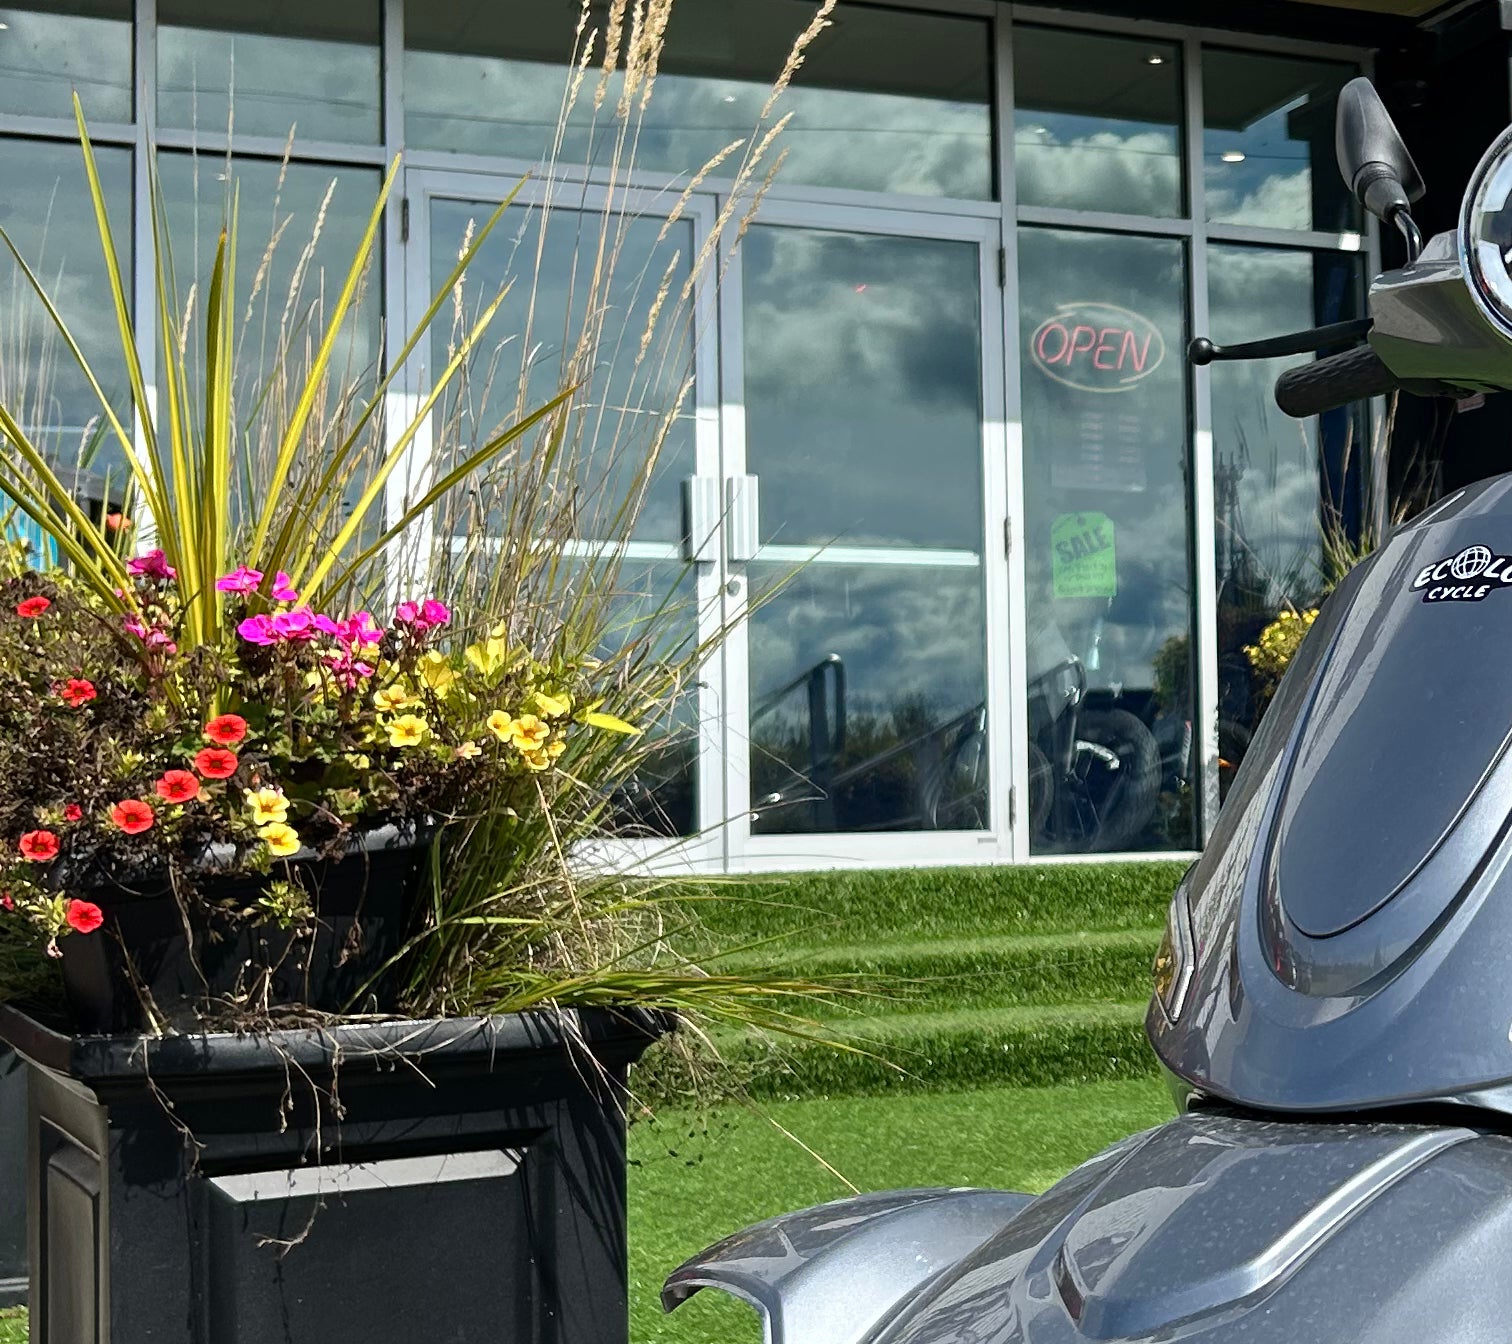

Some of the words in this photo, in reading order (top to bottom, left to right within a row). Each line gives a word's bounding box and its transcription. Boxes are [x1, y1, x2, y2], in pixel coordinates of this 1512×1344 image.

[1038, 323, 1152, 371] OPEN
[1055, 526, 1112, 563] SALE
[1428, 584, 1491, 599] CYCLE
